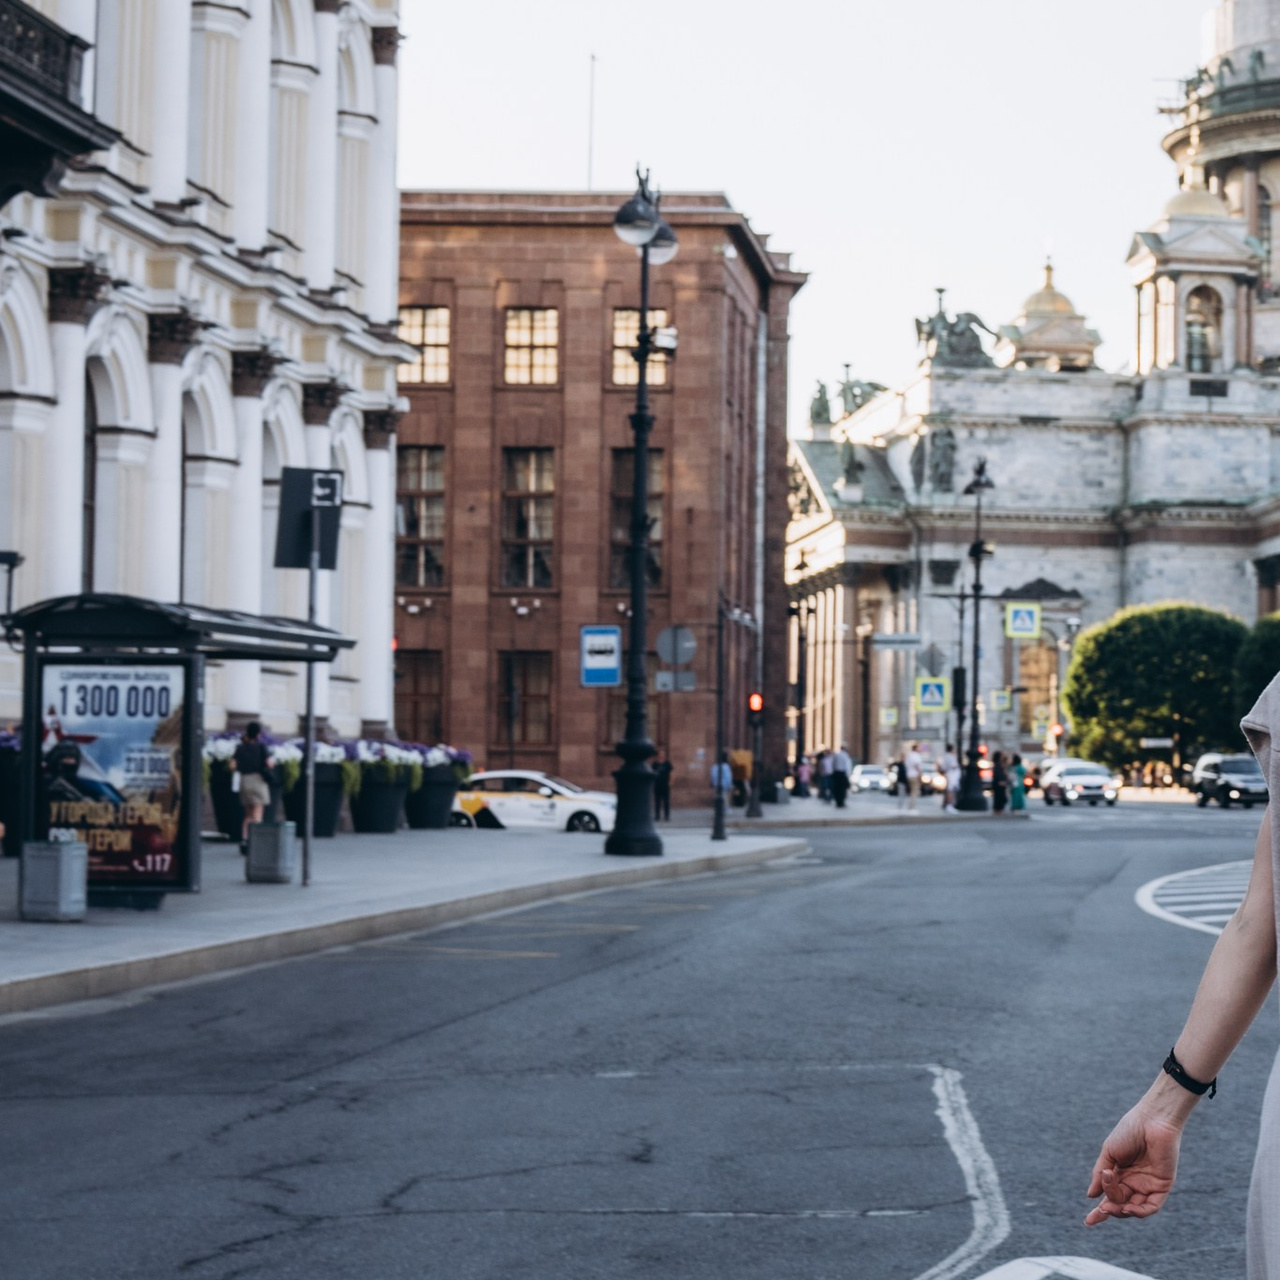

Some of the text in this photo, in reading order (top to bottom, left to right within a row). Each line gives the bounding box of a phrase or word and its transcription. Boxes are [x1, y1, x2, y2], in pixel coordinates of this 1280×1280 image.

[60, 685, 170, 718] 1 300 000
[145, 853, 171, 871] 117
